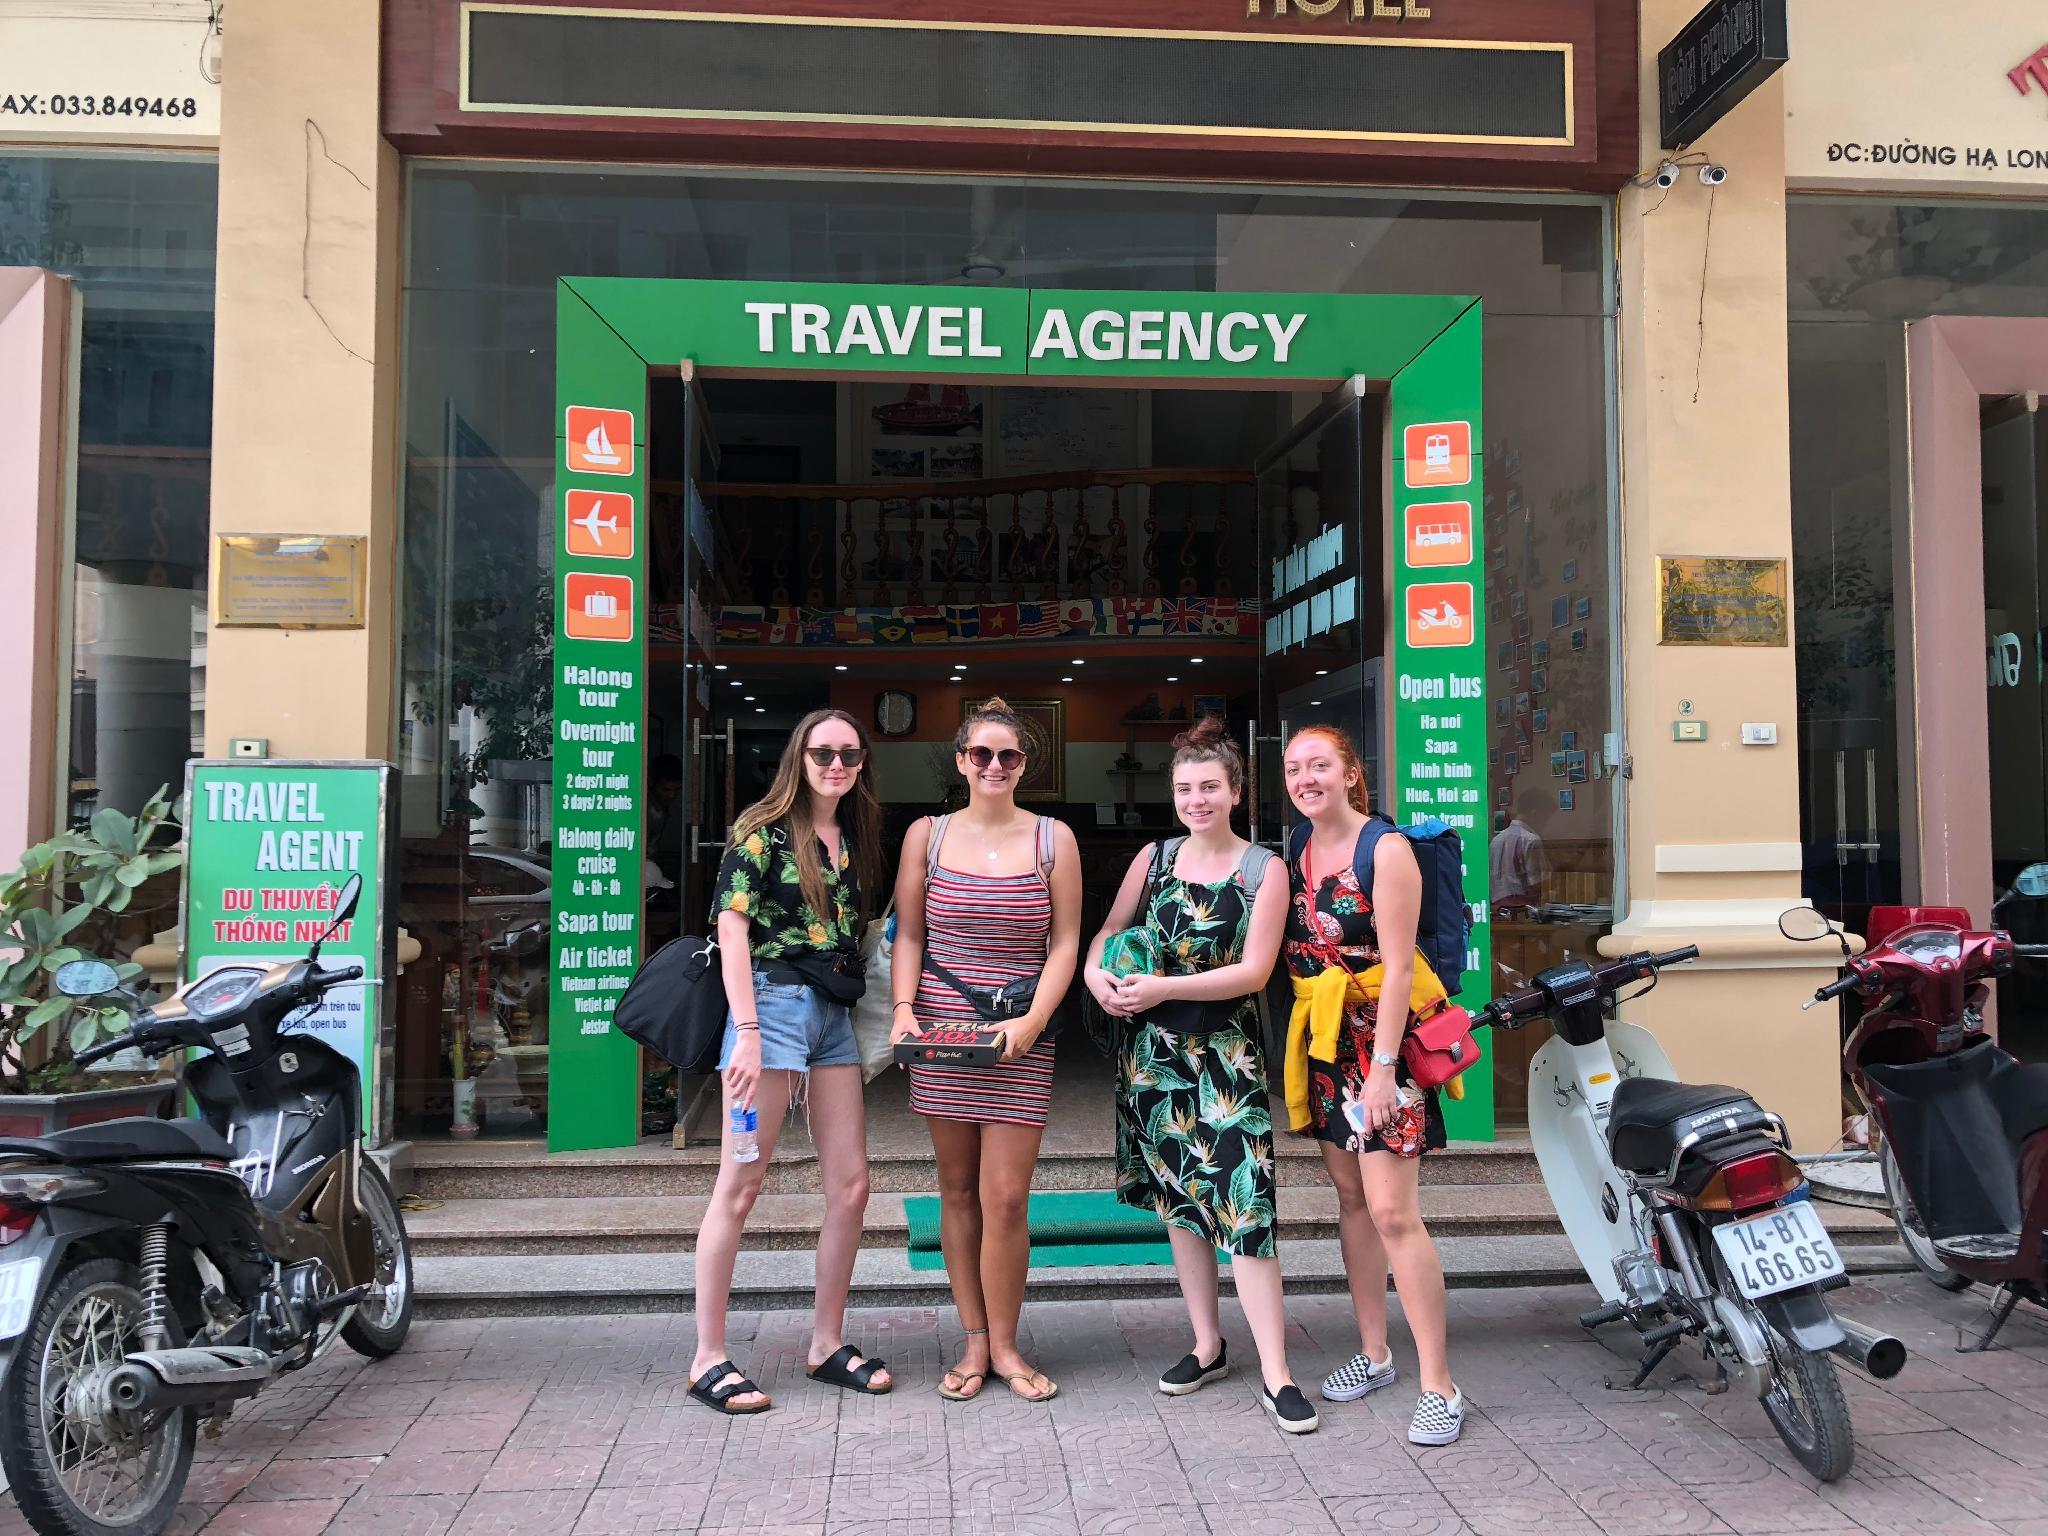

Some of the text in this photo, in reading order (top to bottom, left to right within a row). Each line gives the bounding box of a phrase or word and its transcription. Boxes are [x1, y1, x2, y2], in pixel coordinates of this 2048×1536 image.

[0, 94, 197, 117] AX:033.849468
[1967, 148, 1998, 170] HẠ
[745, 302, 1308, 363] TRAVEL AGENCY
[563, 665, 633, 689] Halong
[1400, 673, 1482, 703] Open bus
[579, 688, 619, 708] tour
[560, 719, 636, 744] Overnight
[1420, 714, 1461, 729] Ha noi
[582, 747, 614, 768] tour
[1425, 738, 1458, 755] Sapa
[1411, 762, 1472, 778] Ninh binh
[566, 773, 573, 788] 2
[605, 773, 629, 790] night
[205, 781, 325, 822] TRAVEL
[562, 794, 569, 809] 3
[596, 794, 603, 809] 2
[604, 794, 633, 811] nights
[1406, 787, 1478, 804] Hue, Hoi an
[559, 827, 635, 851] Halong daily
[256, 830, 364, 872] AGENT
[578, 853, 617, 875] cruise
[572, 879, 585, 896] 4h
[223, 887, 253, 912] DU
[213, 913, 288, 943] THỐNG
[558, 910, 634, 935] Sapa tour
[558, 945, 633, 969] Air ticket
[561, 974, 630, 992] Vietnam airlines
[603, 996, 616, 1012] air
[310, 1020, 330, 1031] open
[332, 1017, 347, 1029] bus
[580, 1018, 611, 1035] Jetstar
[1690, 1106, 1742, 1128] HONDA
[1733, 1210, 1809, 1256] 14-B1
[1740, 1239, 1834, 1291] 466.65
